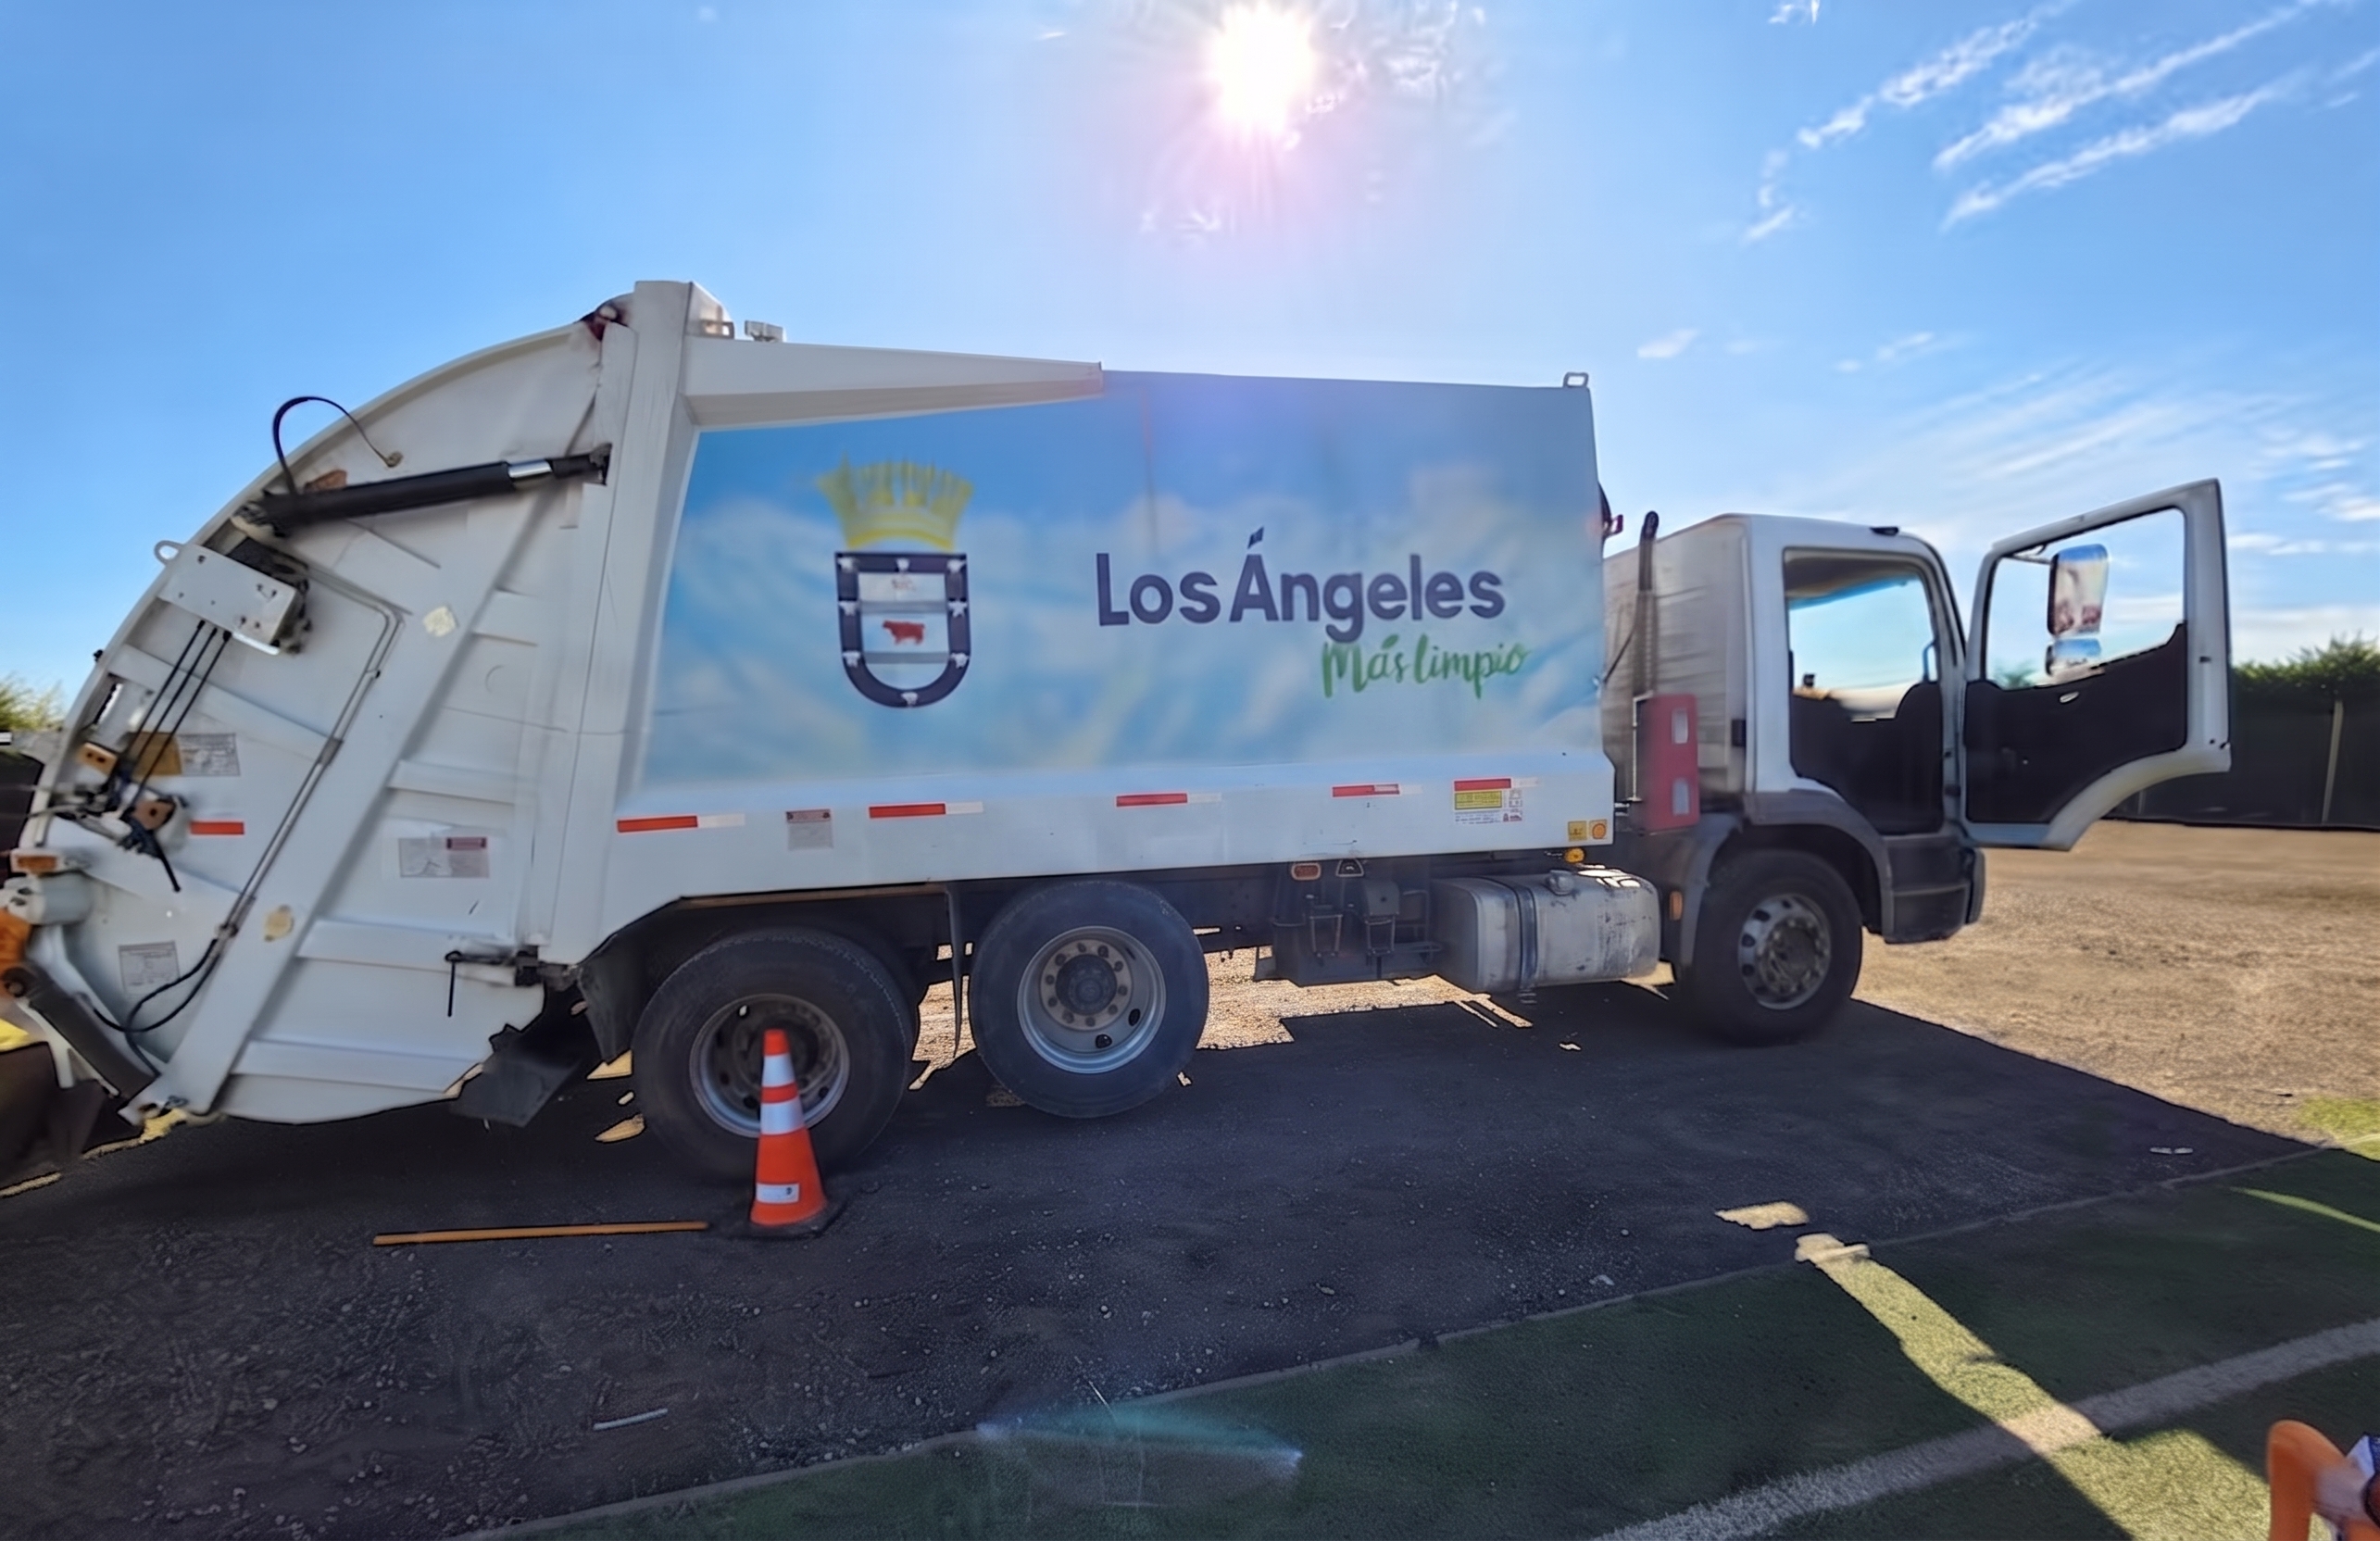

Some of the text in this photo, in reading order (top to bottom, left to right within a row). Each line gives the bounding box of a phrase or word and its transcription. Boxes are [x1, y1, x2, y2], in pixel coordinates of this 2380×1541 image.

[1096, 526, 1506, 644] Los Ángeles
[1322, 633, 1530, 699] Más limpio
